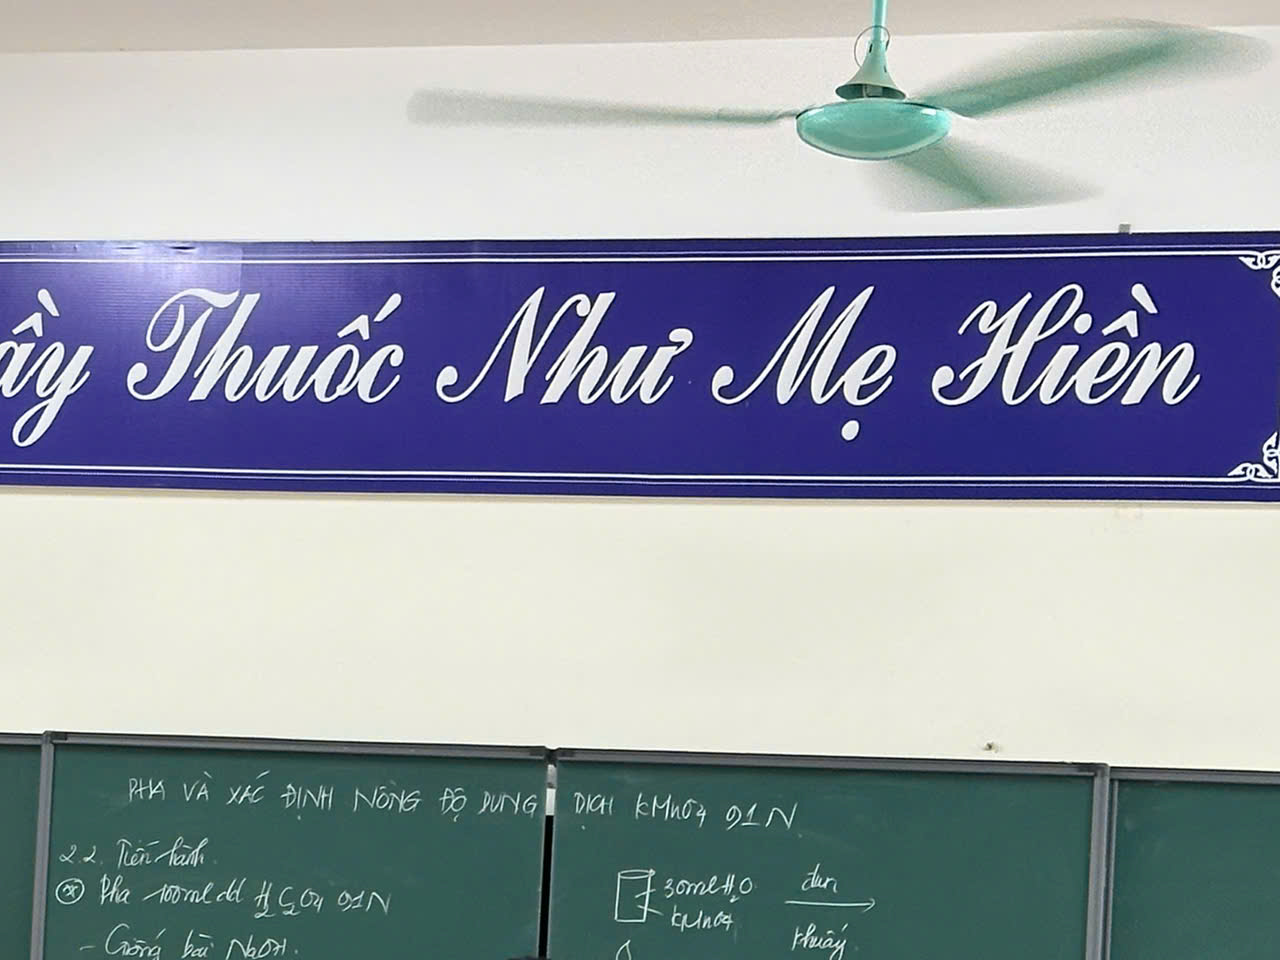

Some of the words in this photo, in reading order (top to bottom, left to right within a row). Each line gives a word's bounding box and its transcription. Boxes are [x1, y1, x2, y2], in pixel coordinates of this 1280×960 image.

[125, 287, 405, 403] Thuốc
[435, 285, 694, 406] Như
[711, 285, 897, 442] Mẹ
[931, 283, 1202, 407] Hiền
[126, 776, 167, 804] PHA
[183, 769, 214, 803] VÀ
[225, 768, 271, 806] XÁC
[279, 782, 335, 822] ĐỊNH
[351, 778, 421, 814] NỒNG
[439, 786, 469, 824] ĐỘ
[476, 788, 539, 818] DUNG
[99, 873, 131, 906] Pha
[181, 927, 214, 960] bài
